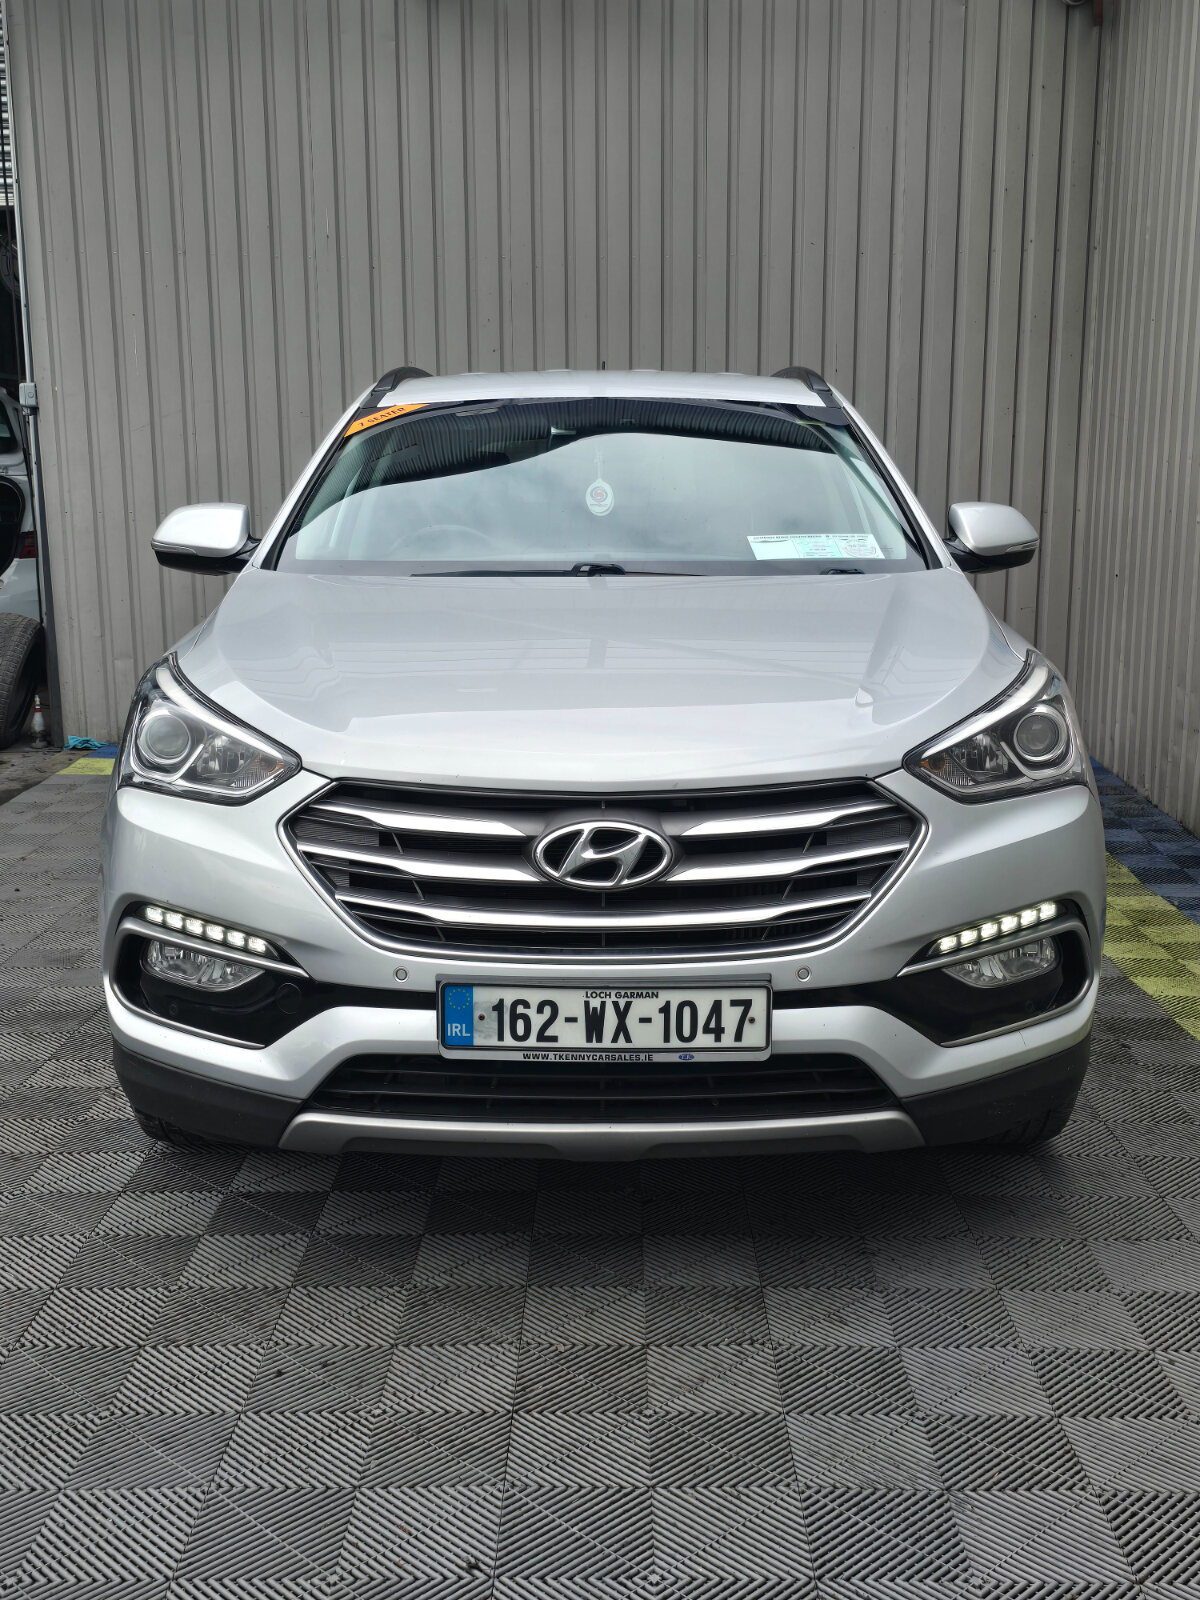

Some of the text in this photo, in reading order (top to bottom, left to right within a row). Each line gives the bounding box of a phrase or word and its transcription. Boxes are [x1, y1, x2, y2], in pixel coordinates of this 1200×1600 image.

[585, 991, 659, 999] LOCH GARMAN
[491, 998, 753, 1043] 162-WX-1047
[447, 1023, 470, 1037] IRL
[522, 1052, 654, 1062] WWW.TKENNYCARSALES.IE
